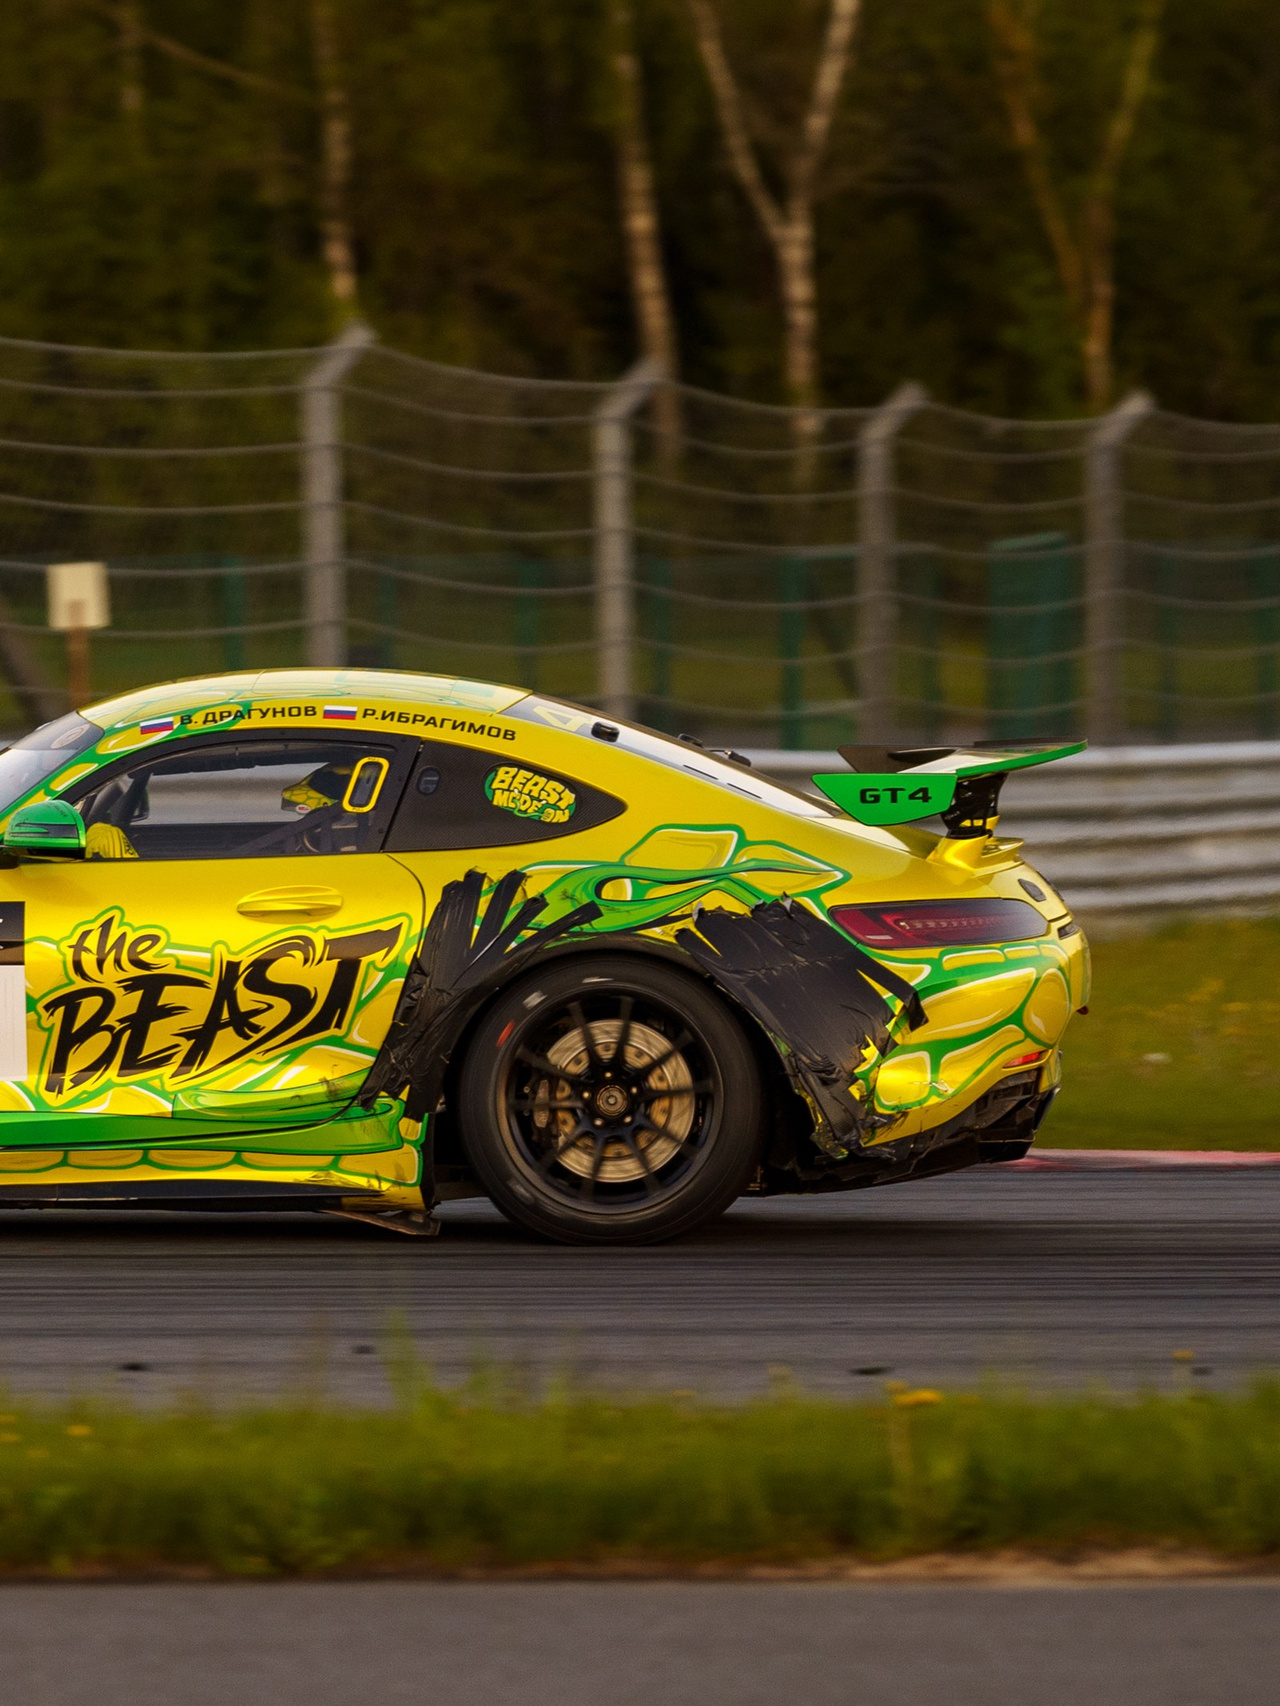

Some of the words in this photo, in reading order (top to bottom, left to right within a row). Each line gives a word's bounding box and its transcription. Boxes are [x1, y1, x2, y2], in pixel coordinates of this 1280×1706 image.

[180, 714, 198, 725] В.
[202, 705, 317, 725] ДРАГУНОВ
[362, 708, 517, 741] Р.ИБРАГИМОВ
[491, 766, 576, 810] BEAST
[859, 786, 932, 804] GT4
[67, 914, 170, 984] the
[43, 921, 404, 1099] BEAST
